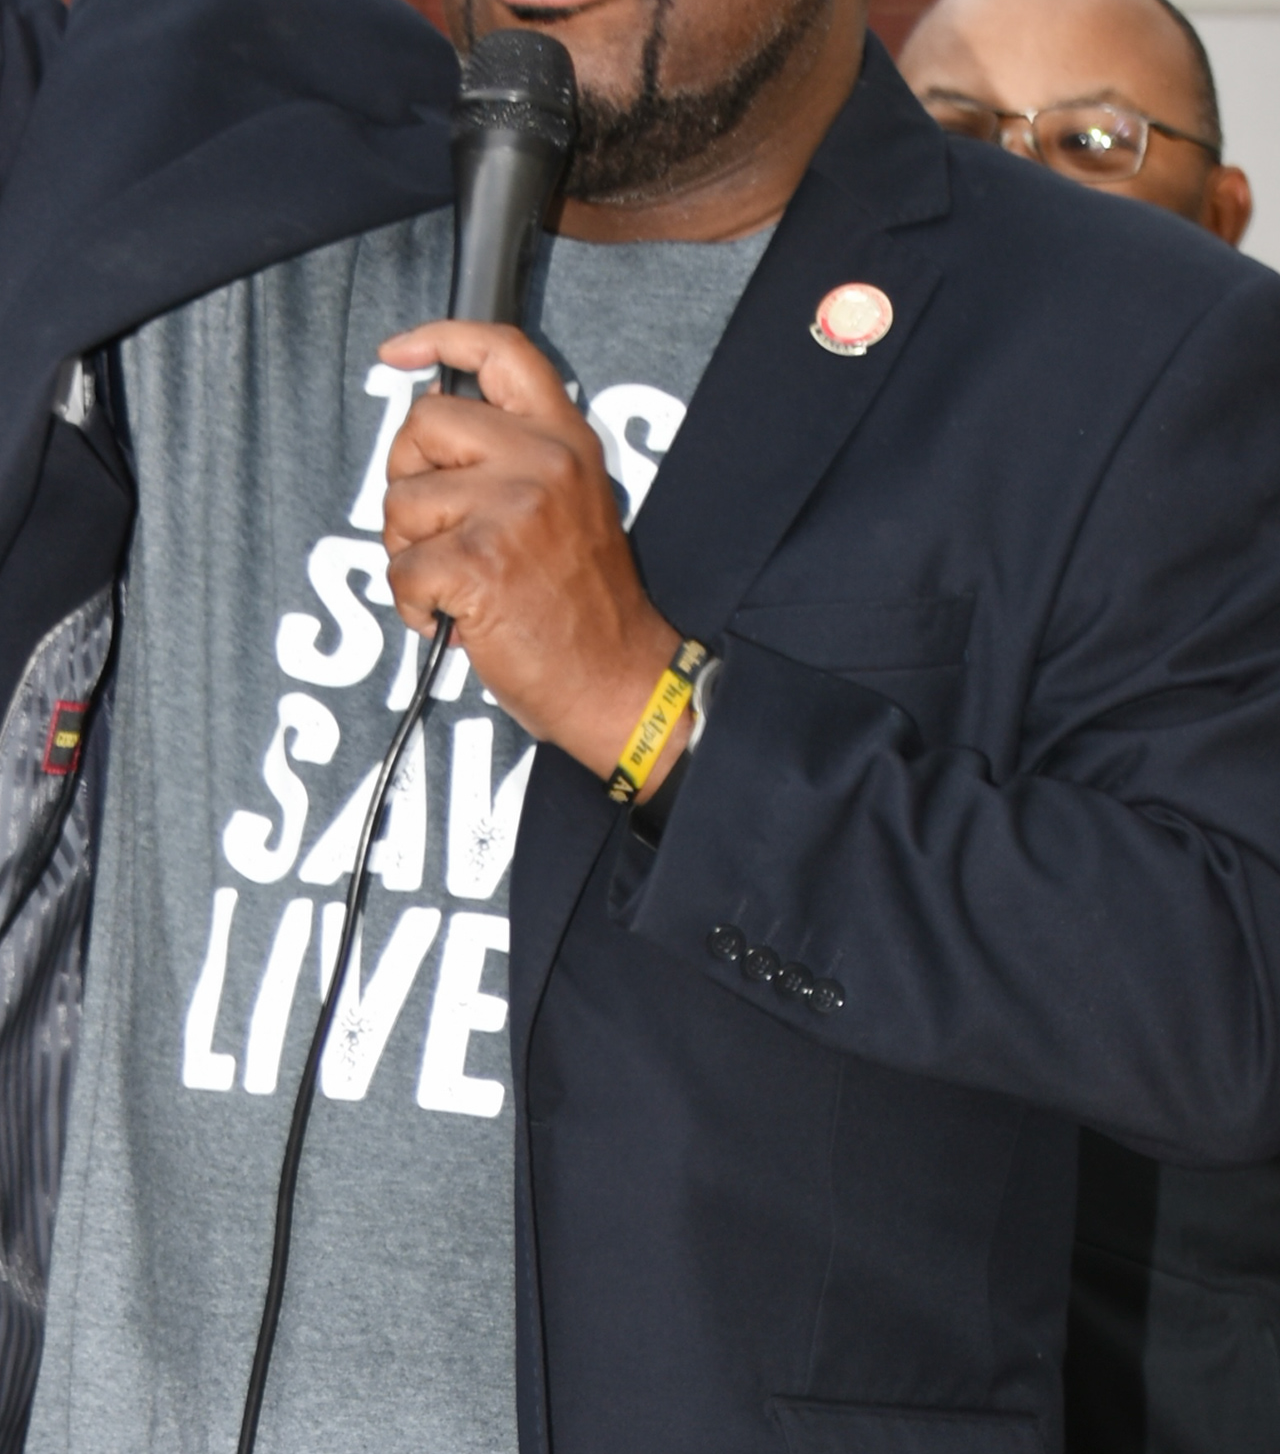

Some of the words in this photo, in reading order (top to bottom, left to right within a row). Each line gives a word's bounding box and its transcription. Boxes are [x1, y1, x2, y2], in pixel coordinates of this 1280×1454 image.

[629, 703, 668, 767] Alpha
[661, 678, 688, 709] Phi
[223, 691, 537, 900] SAV
[182, 887, 510, 1119] LIVE
